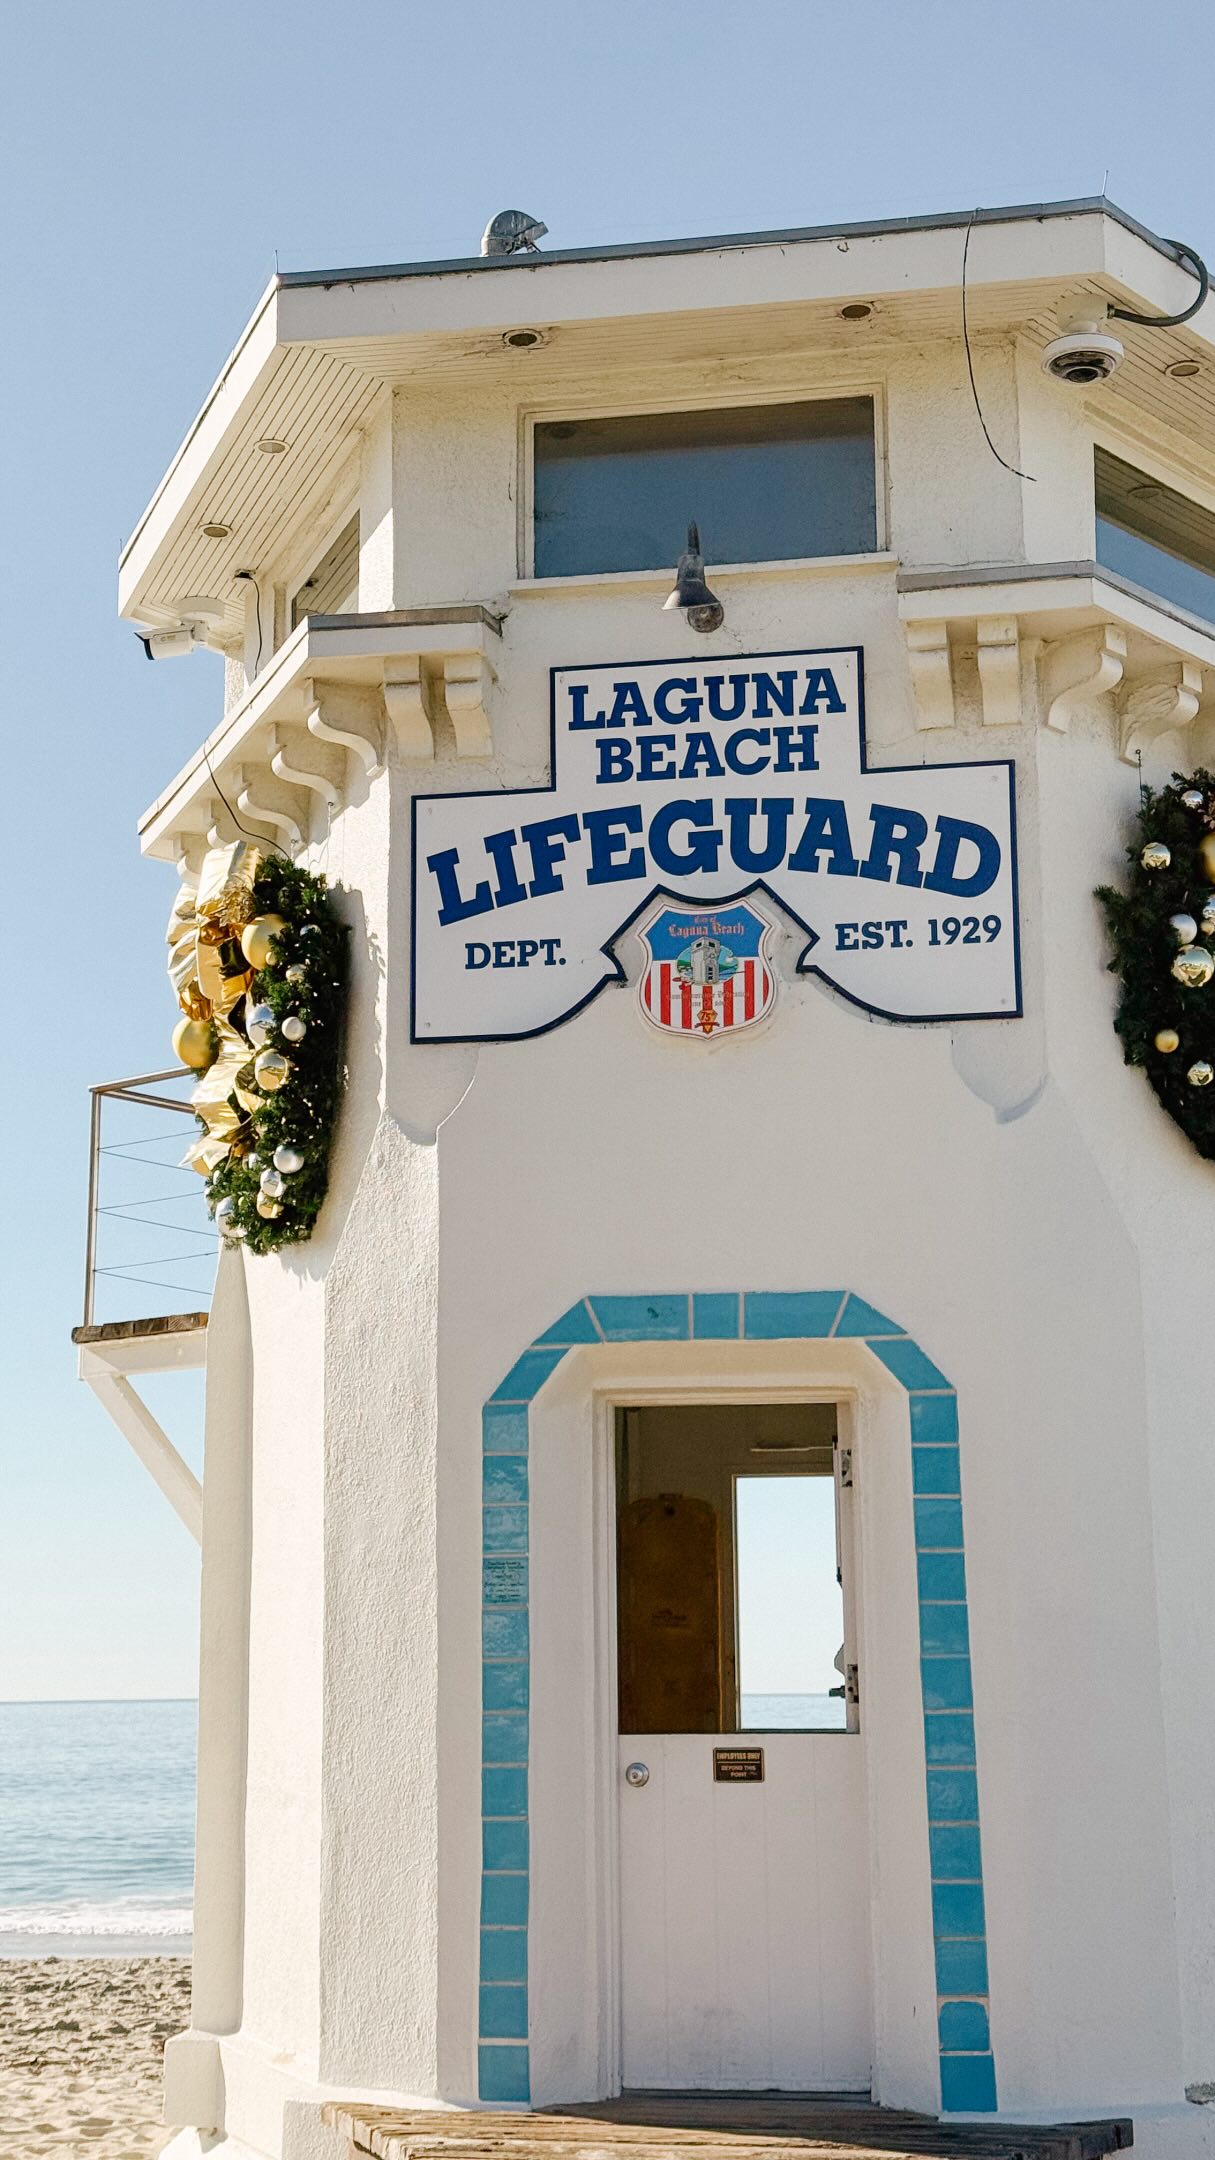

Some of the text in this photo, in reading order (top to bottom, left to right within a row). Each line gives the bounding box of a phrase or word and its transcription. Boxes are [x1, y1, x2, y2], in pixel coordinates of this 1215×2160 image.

[567, 667, 847, 732] LAGUNA
[595, 724, 820, 785] BEACH
[426, 797, 1002, 927] LIFEGUARD
[464, 938, 567, 970] DEPT.
[669, 922, 745, 938] Laguna Beach
[834, 914, 1002, 952] EST. 1929
